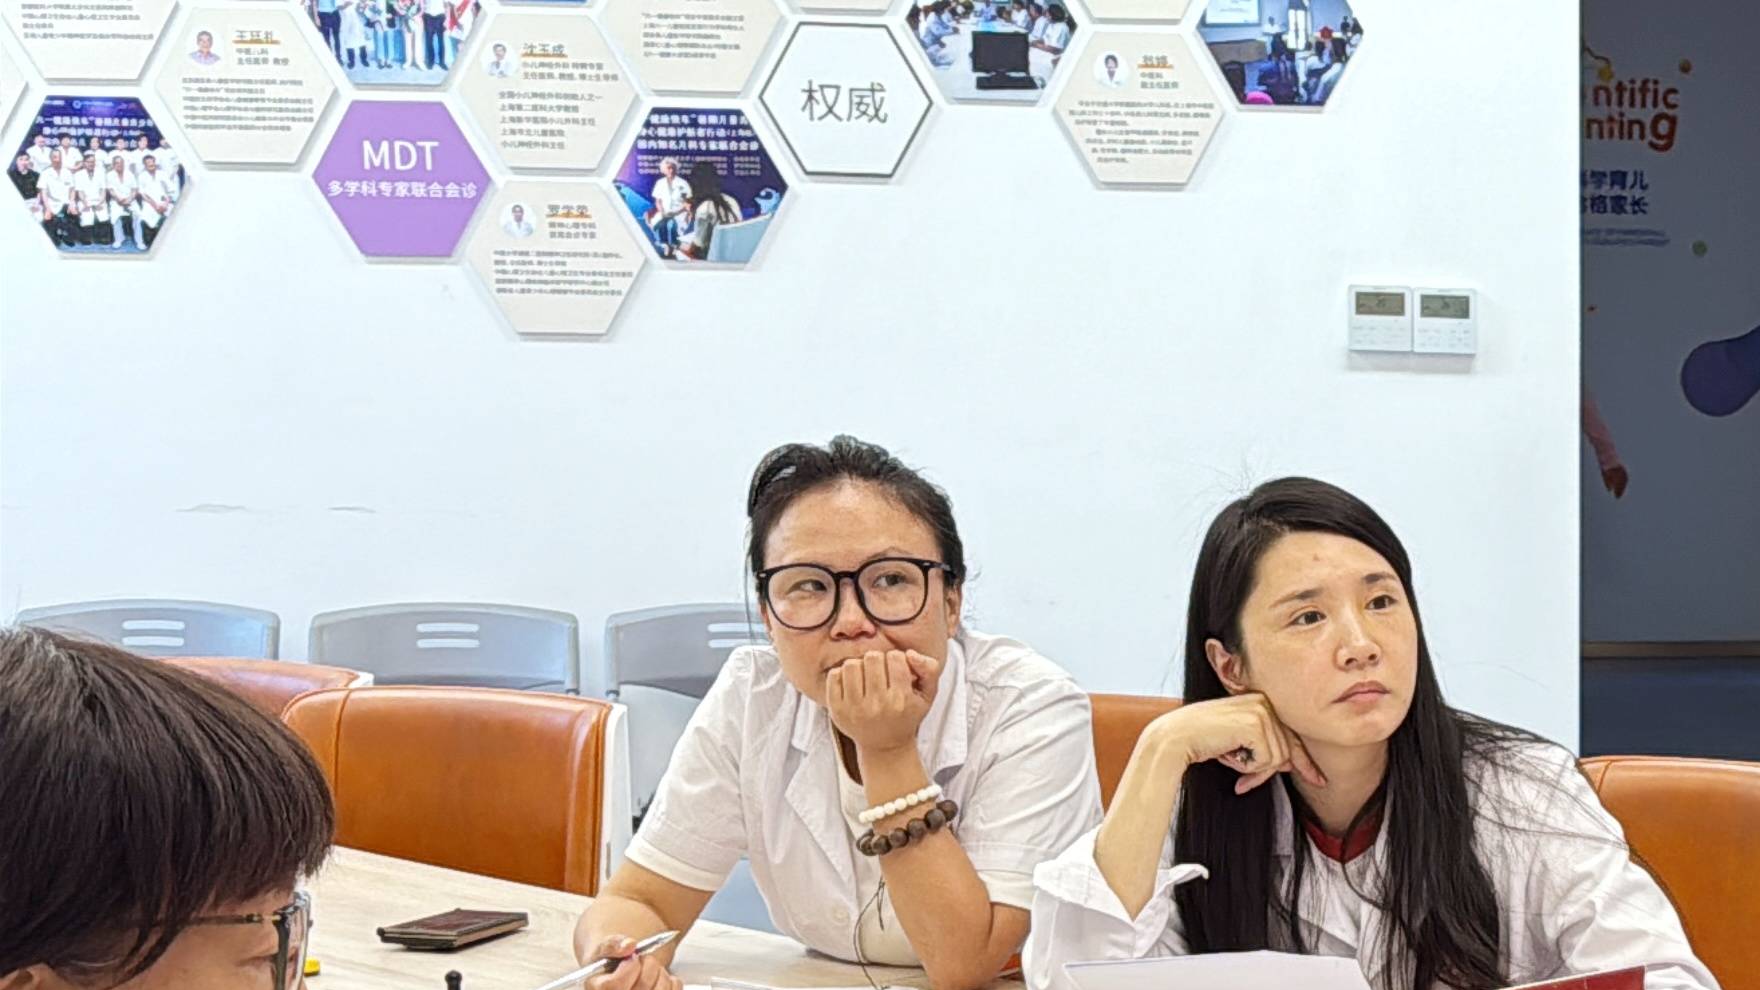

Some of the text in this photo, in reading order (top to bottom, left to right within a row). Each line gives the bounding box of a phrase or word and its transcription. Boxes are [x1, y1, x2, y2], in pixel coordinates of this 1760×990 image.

[801, 80, 888, 123] 权威
[362, 140, 440, 171] MDT
[327, 179, 478, 199] 多学科专家联合会诊
